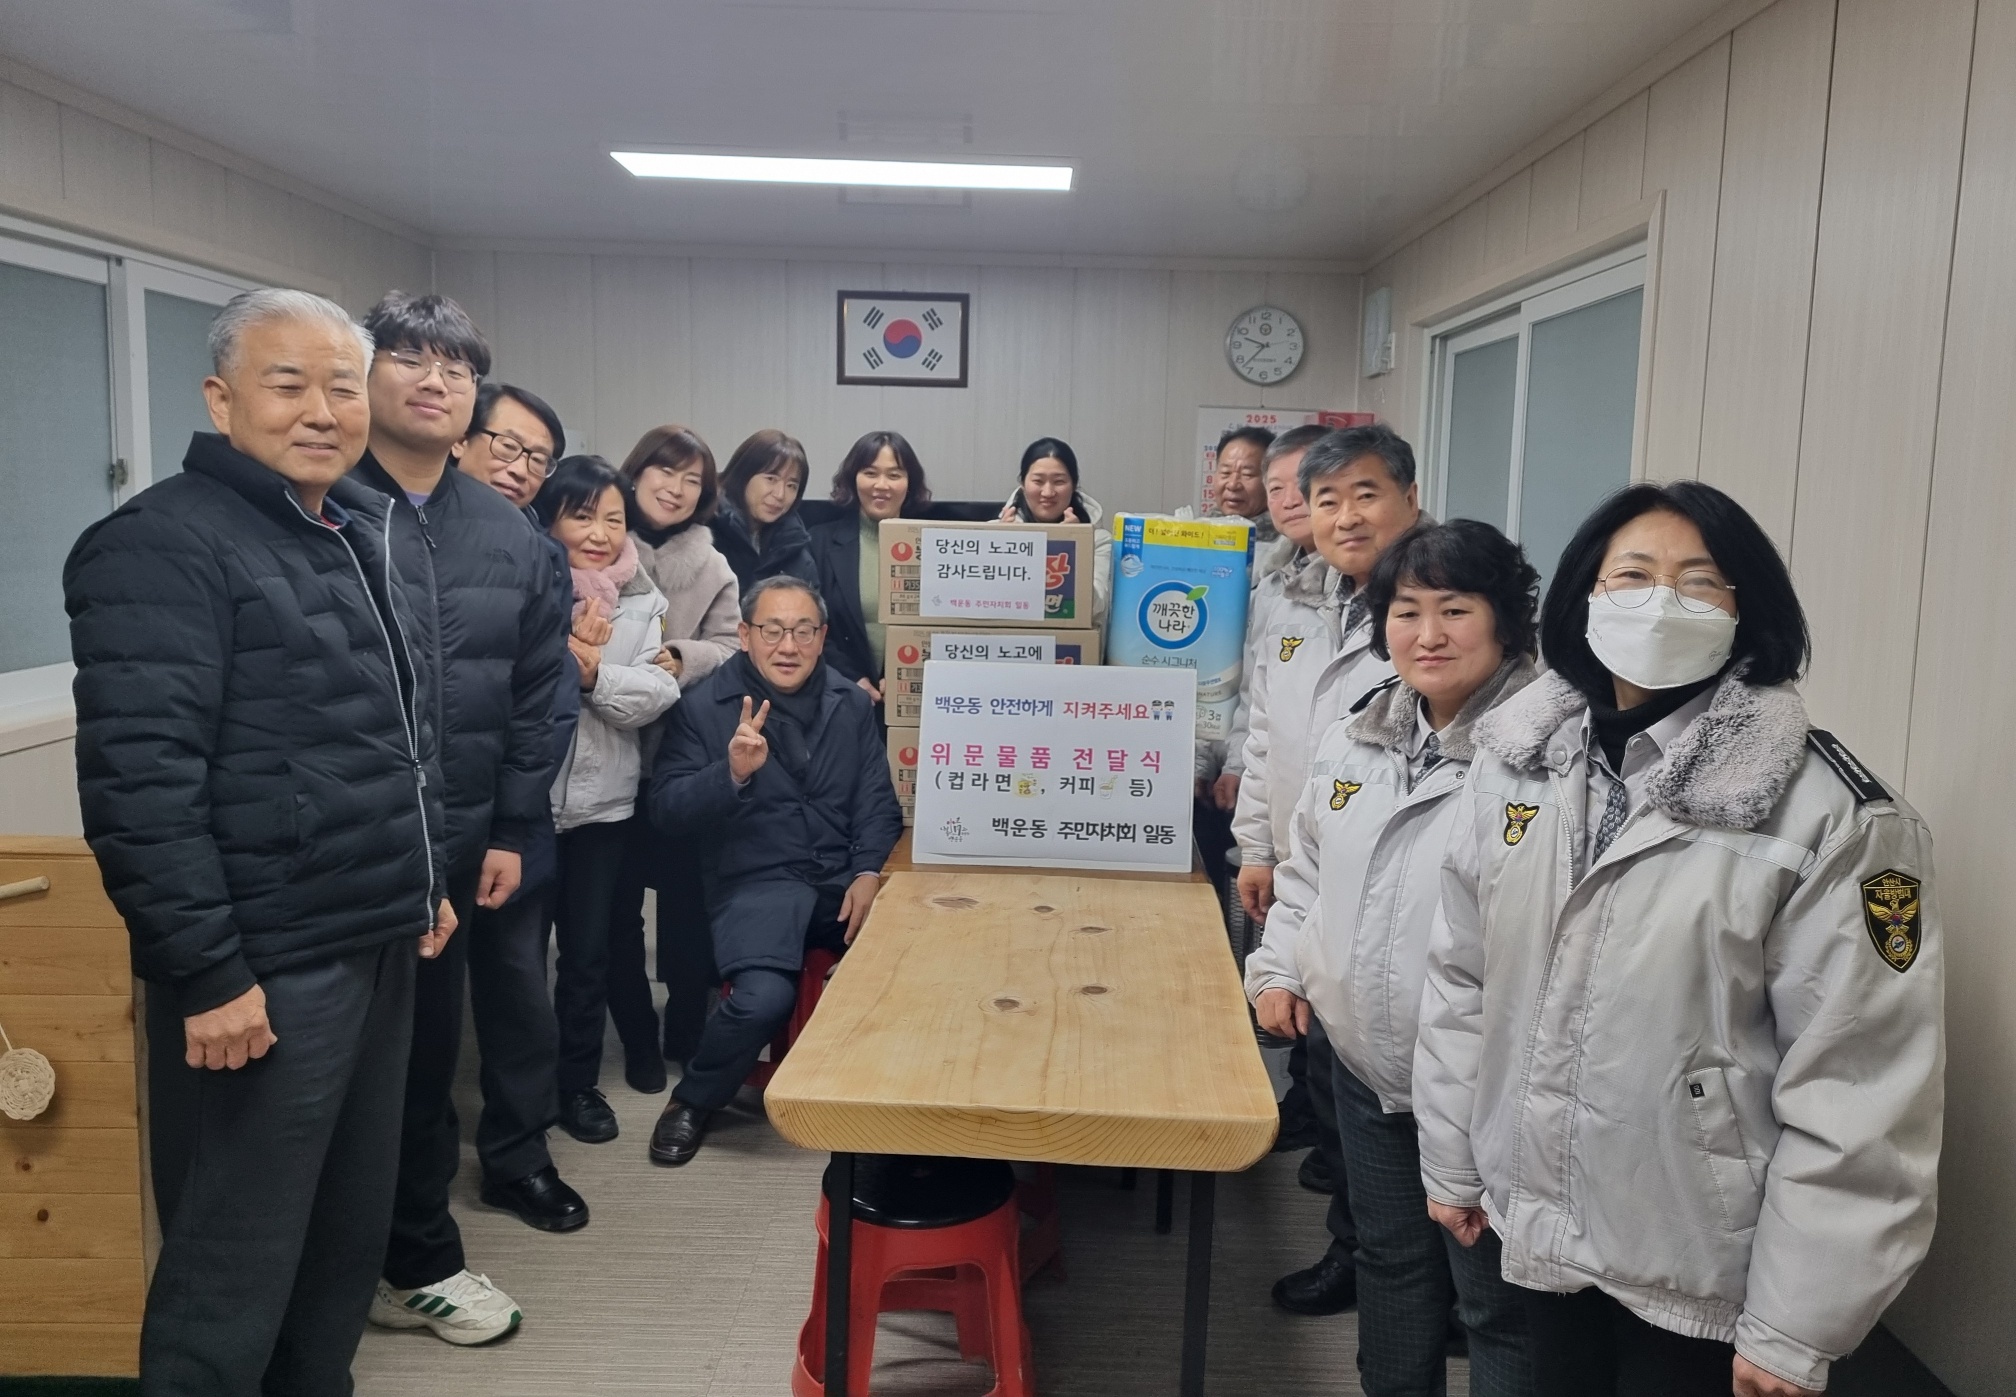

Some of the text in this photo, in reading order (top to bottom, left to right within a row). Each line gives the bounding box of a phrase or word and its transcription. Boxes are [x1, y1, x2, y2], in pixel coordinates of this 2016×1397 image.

[1248, 316, 1256, 324] 11
[1261, 312, 1272, 320] 12
[1237, 327, 1249, 336] 10
[1286, 328, 1295, 337] 2
[1232, 341, 1242, 350] 9
[1289, 342, 1298, 350] 3
[1235, 355, 1245, 364] 8
[1284, 356, 1293, 364] 4
[1245, 367, 1254, 375] 7
[1259, 370, 1268, 380] 6
[1273, 367, 1282, 376] 5
[1246, 414, 1277, 424] 2025
[1206, 475, 1213, 484] 8
[1203, 489, 1215, 499] 15
[1124, 524, 1142, 533] NEW
[936, 539, 980, 555] 당신의
[988, 541, 1034, 557] 노고에
[937, 563, 1031, 581] 감사드립니다.
[1152, 602, 1195, 619] 깨끗한
[1158, 619, 1187, 633] 나라
[945, 643, 989, 660] 당신의
[997, 645, 1043, 661] 노고에
[1141, 654, 1198, 668] 순수 시그니처
[935, 696, 1150, 720] 백운동 안전하게 지켜주세요
[1060, 776, 1095, 795] 커피
[1129, 778, 1153, 797] 등)
[992, 817, 1048, 839] 백운동
[1057, 821, 1136, 843] 주민자치회
[1143, 824, 1176, 845] 일동
